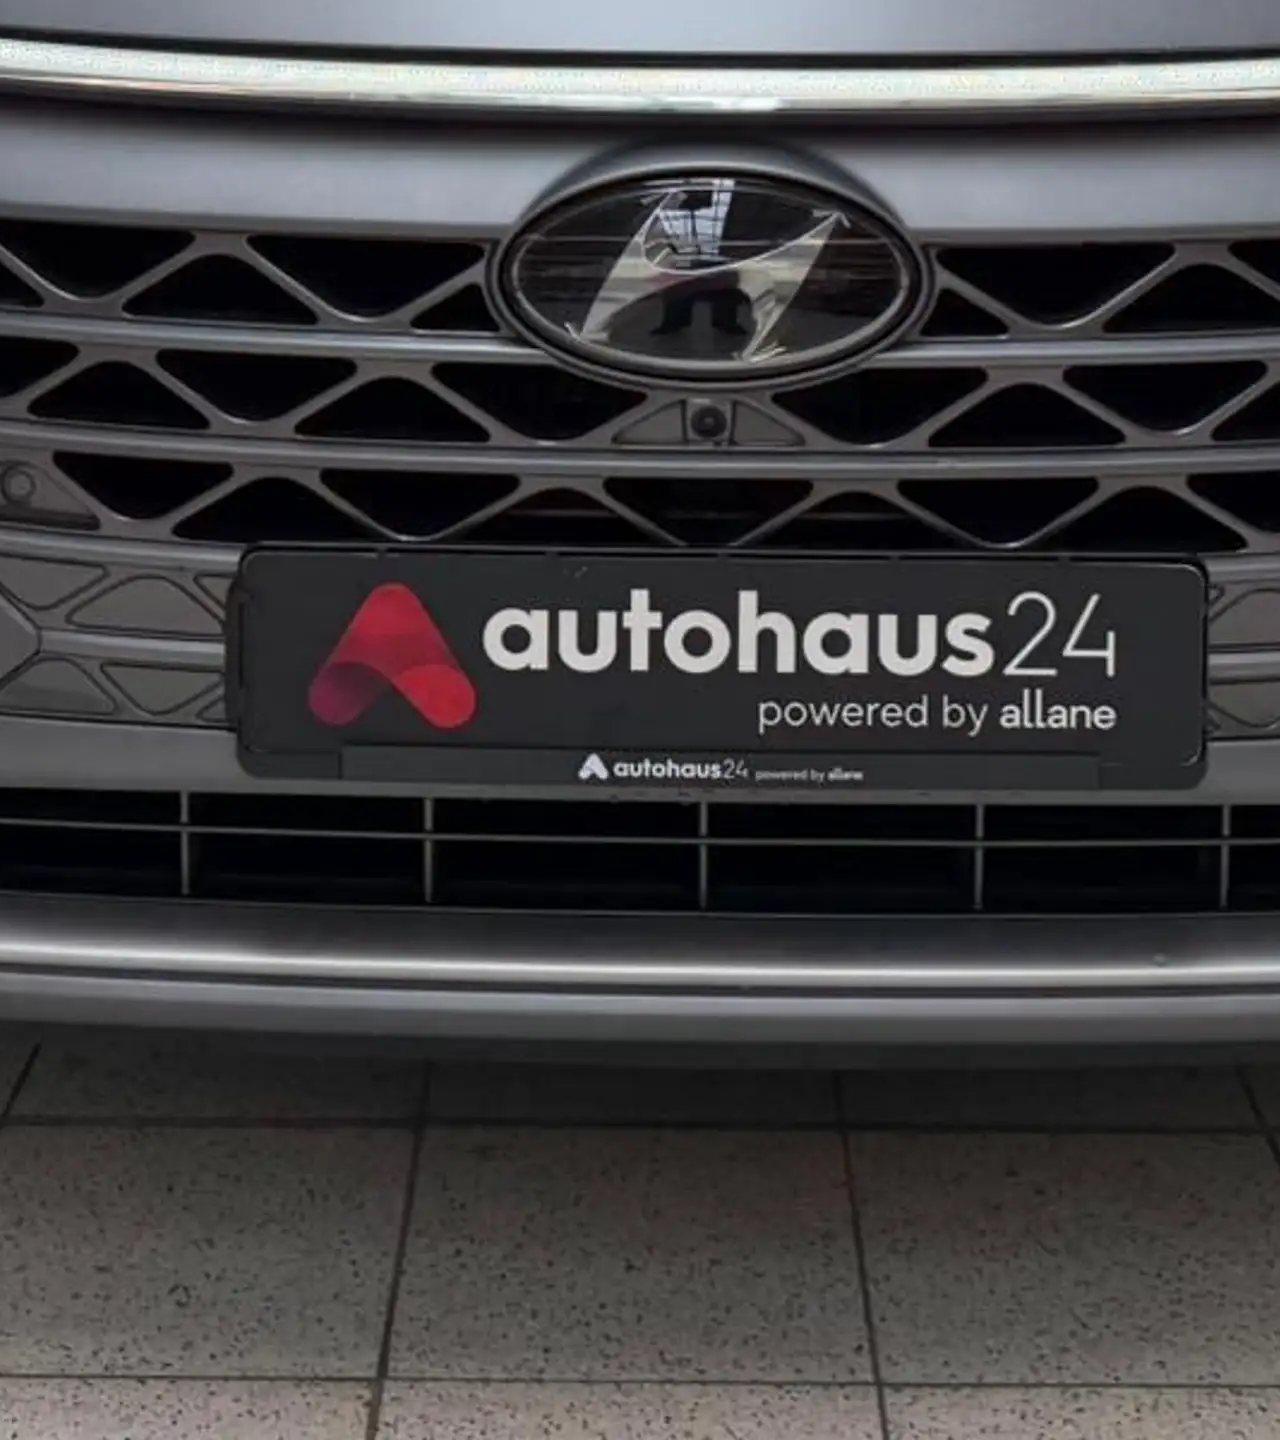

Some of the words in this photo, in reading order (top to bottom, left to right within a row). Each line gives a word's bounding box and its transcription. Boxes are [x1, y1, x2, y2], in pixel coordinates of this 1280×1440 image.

[482, 588, 1116, 678] autohaus24
[757, 693, 929, 734] powered
[942, 693, 989, 737] by
[999, 688, 1117, 730] allane
[613, 758, 749, 780] autohaus24
[755, 769, 808, 781] powered
[810, 768, 825, 783] by
